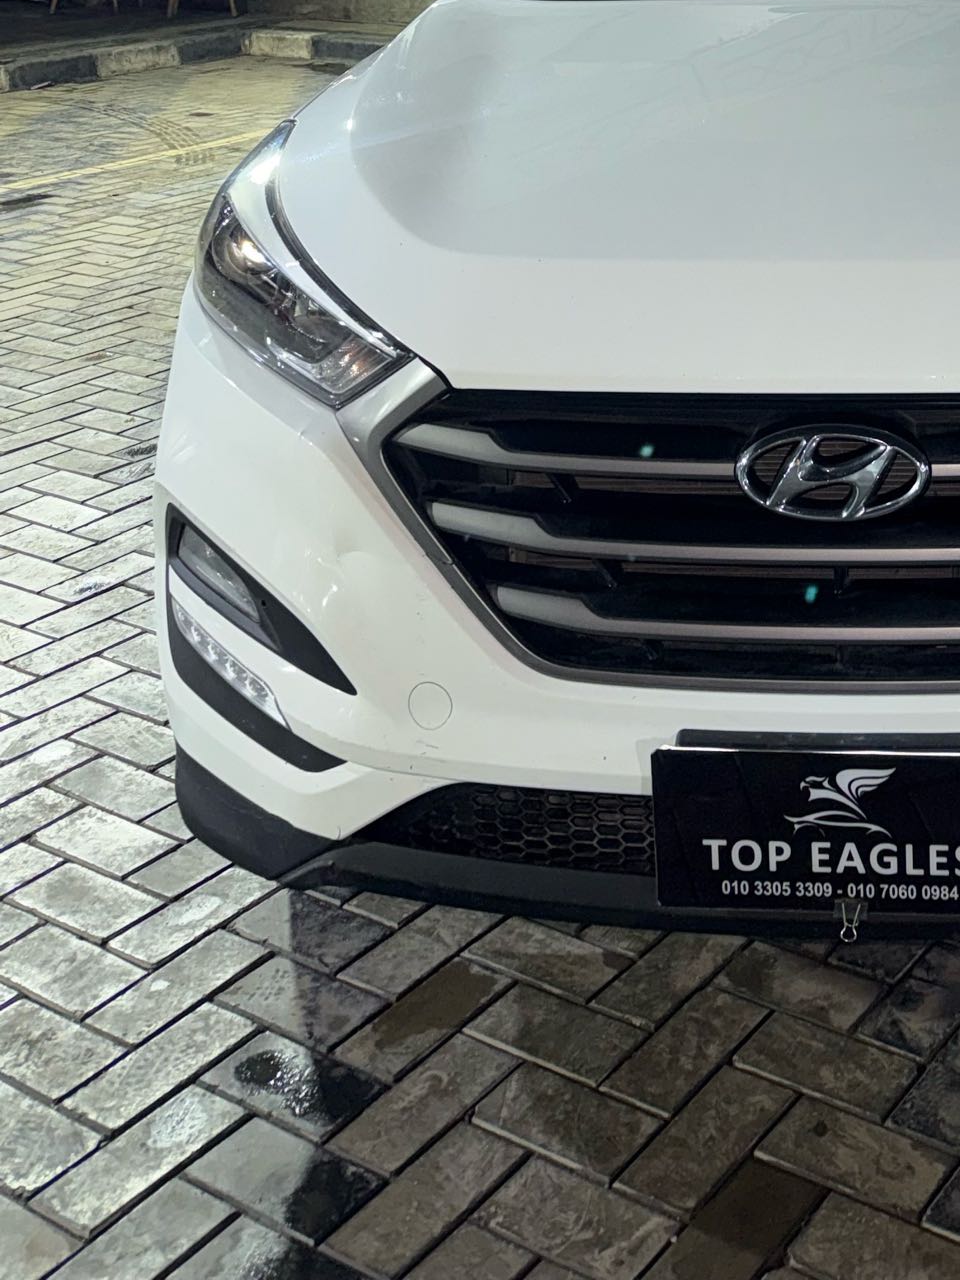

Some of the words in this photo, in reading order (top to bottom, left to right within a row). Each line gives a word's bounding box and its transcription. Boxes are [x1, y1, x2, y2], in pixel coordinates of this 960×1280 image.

[702, 839, 792, 872] TOP
[721, 880, 749, 895] 010
[754, 880, 791, 896] 3305
[795, 881, 833, 897] 3309
[847, 883, 875, 898] 010
[879, 884, 917, 900] 7060
[921, 885, 959, 900] 0984
